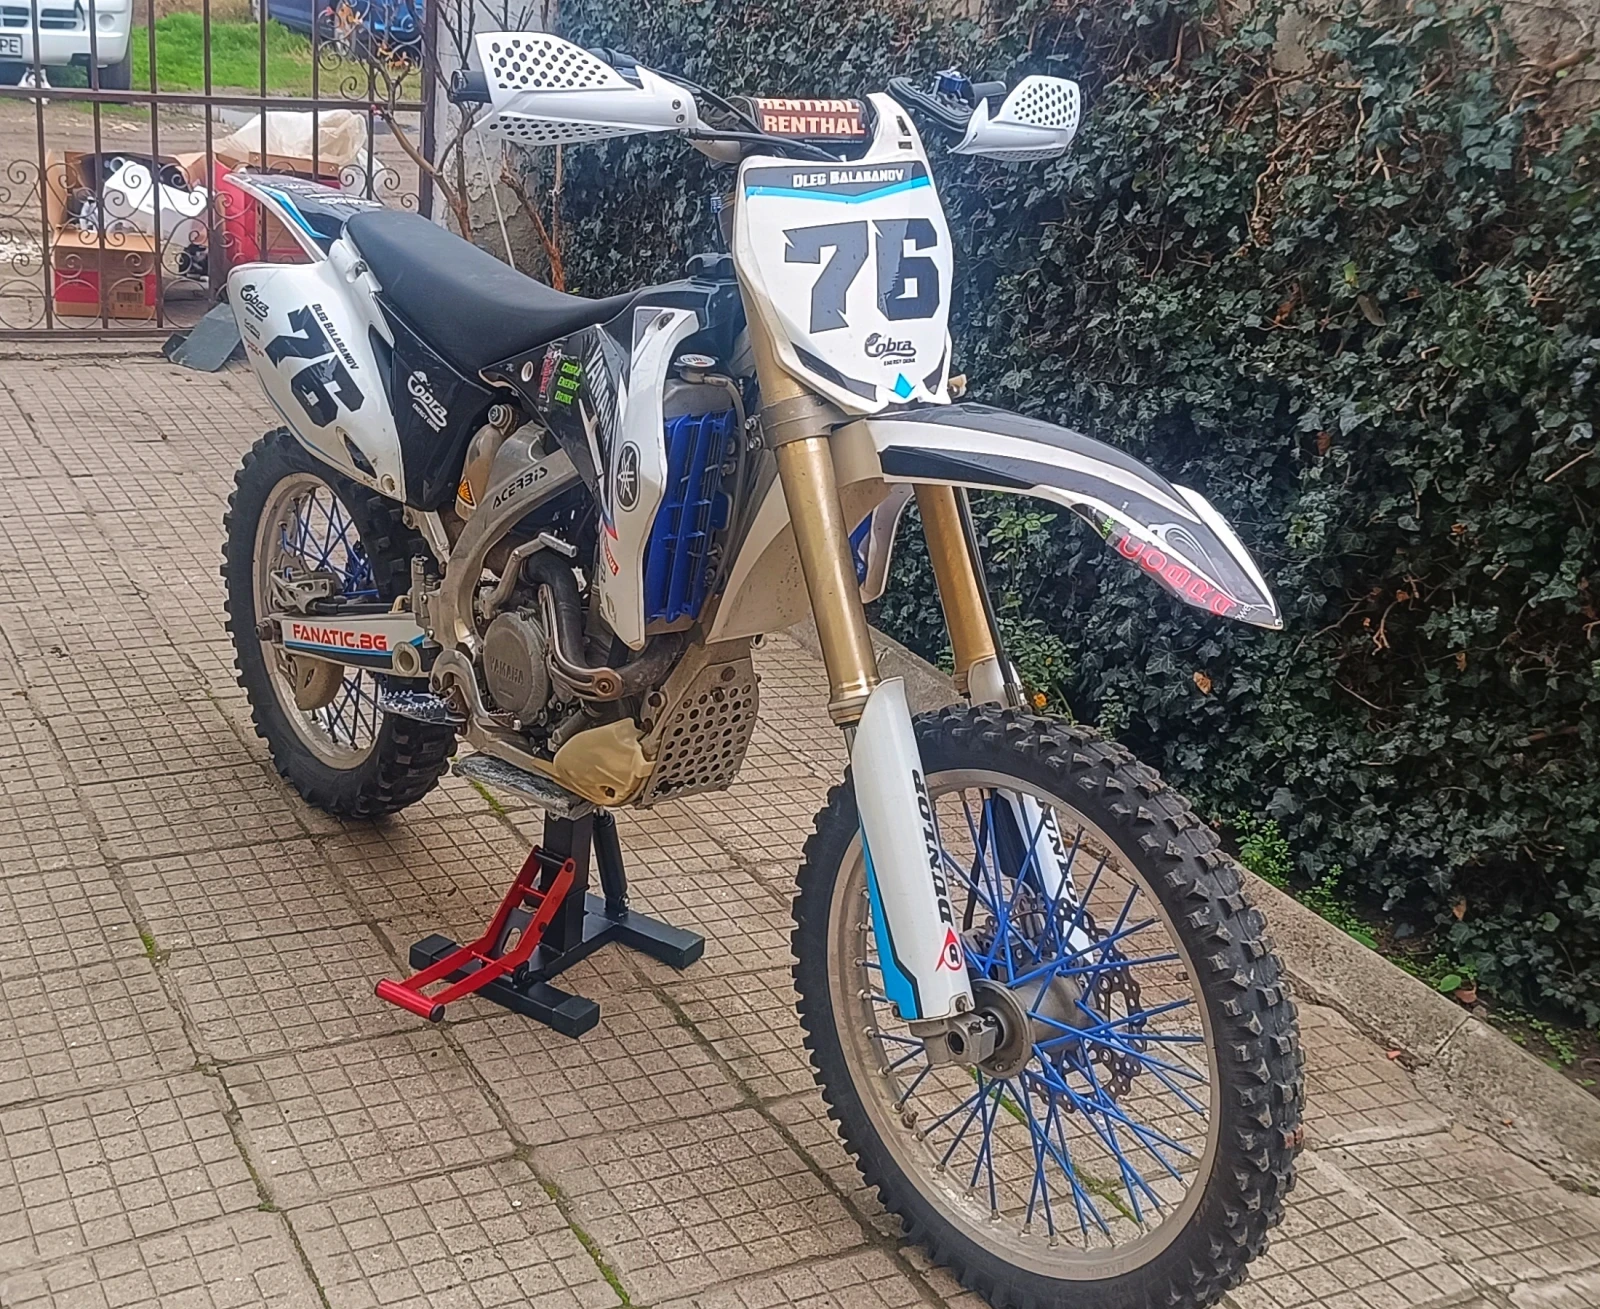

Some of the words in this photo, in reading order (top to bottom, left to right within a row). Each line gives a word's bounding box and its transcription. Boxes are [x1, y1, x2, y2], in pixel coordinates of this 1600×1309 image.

[763, 114, 865, 134] RENTHAL
[792, 173, 827, 188] OLEG
[829, 169, 904, 184] BALABANOV
[782, 217, 940, 333] 76
[240, 284, 269, 318] Cobra
[864, 332, 917, 360] Cobra
[265, 305, 365, 428] 76
[407, 370, 447, 427] Cobra
[292, 623, 388, 651] FANATIC.BG
[912, 769, 954, 925] DUNLOP
